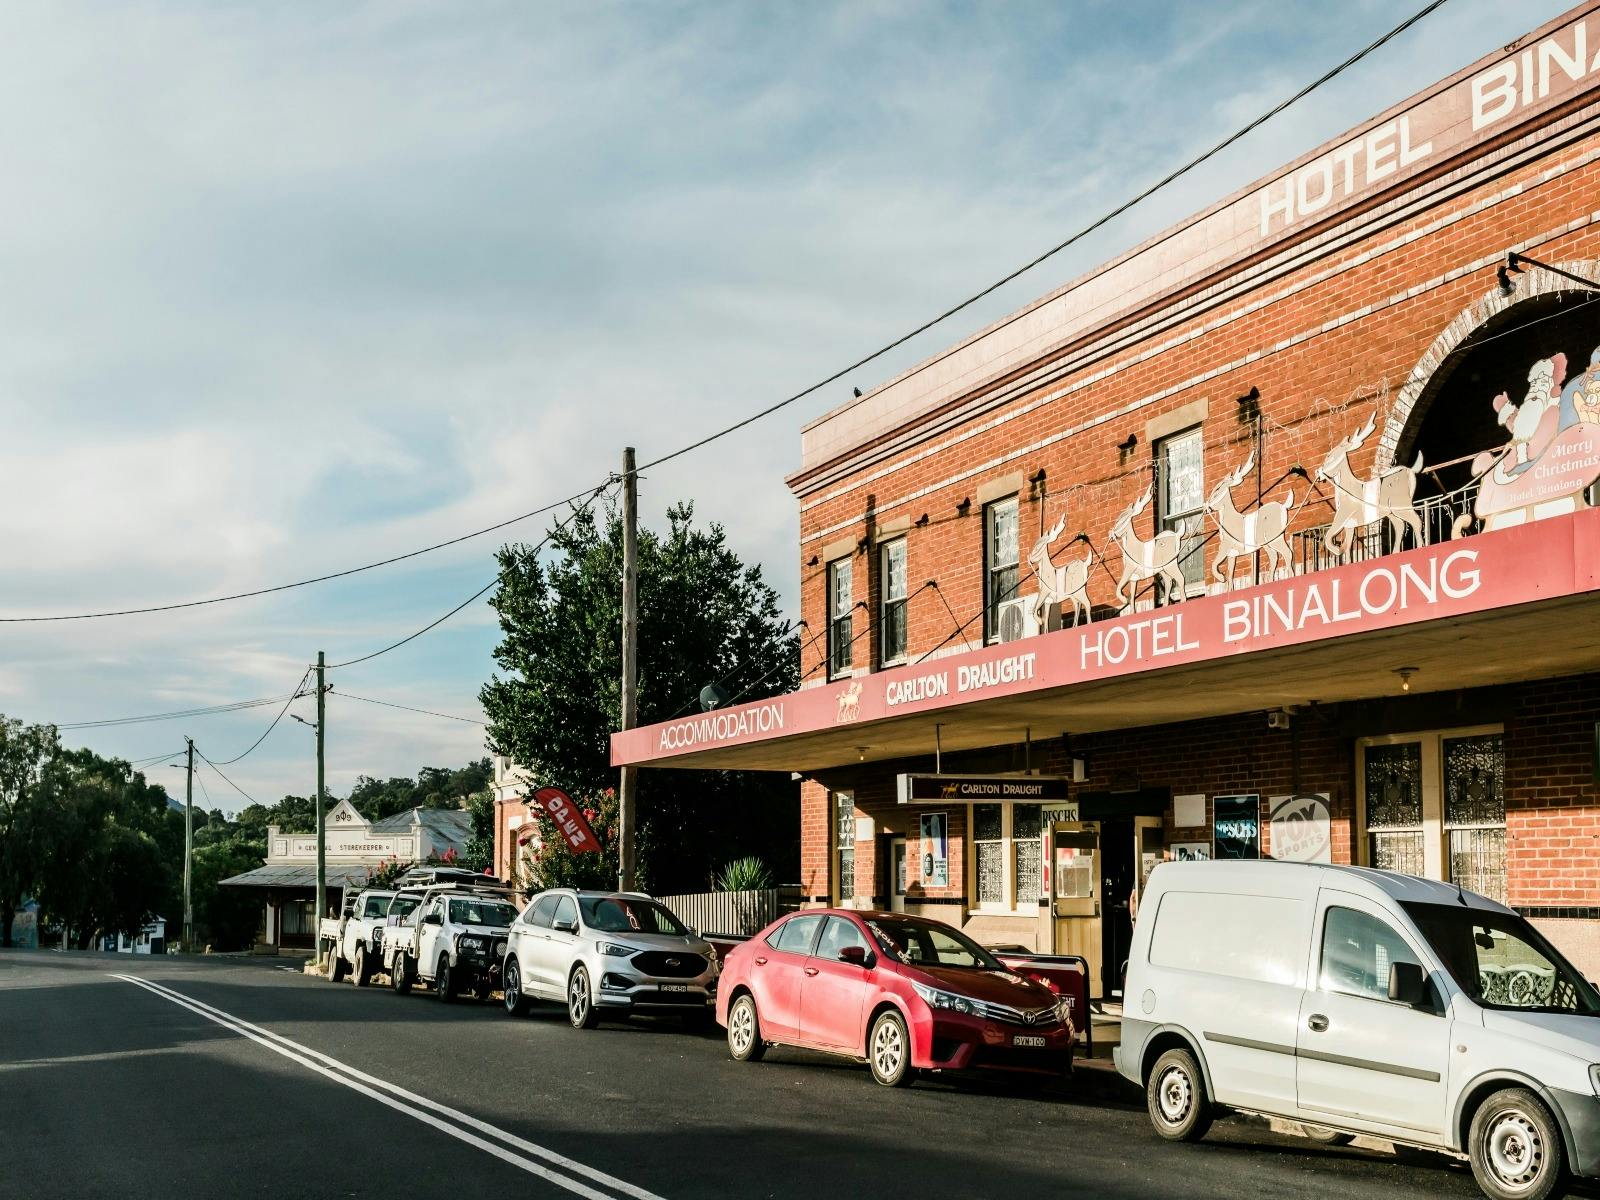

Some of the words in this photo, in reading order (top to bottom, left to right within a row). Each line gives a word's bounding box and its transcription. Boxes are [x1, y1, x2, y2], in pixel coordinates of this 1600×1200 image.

[1259, 115, 1433, 237] HOTEL
[1534, 455, 1600, 479] Christmas
[1551, 439, 1593, 459] Merry
[1080, 613, 1200, 670] HOTEL
[1223, 549, 1482, 643] BINALONG
[886, 671, 949, 706] CARLTON
[957, 652, 1036, 693] DRAUGHT
[659, 703, 784, 750] ACCOMMODATION
[961, 784, 1000, 794] CARLTON
[1003, 784, 1042, 795] DRAUGHT
[548, 797, 586, 847] OPEN
[1272, 802, 1321, 849] FOX
[1278, 834, 1324, 858] SPORTS
